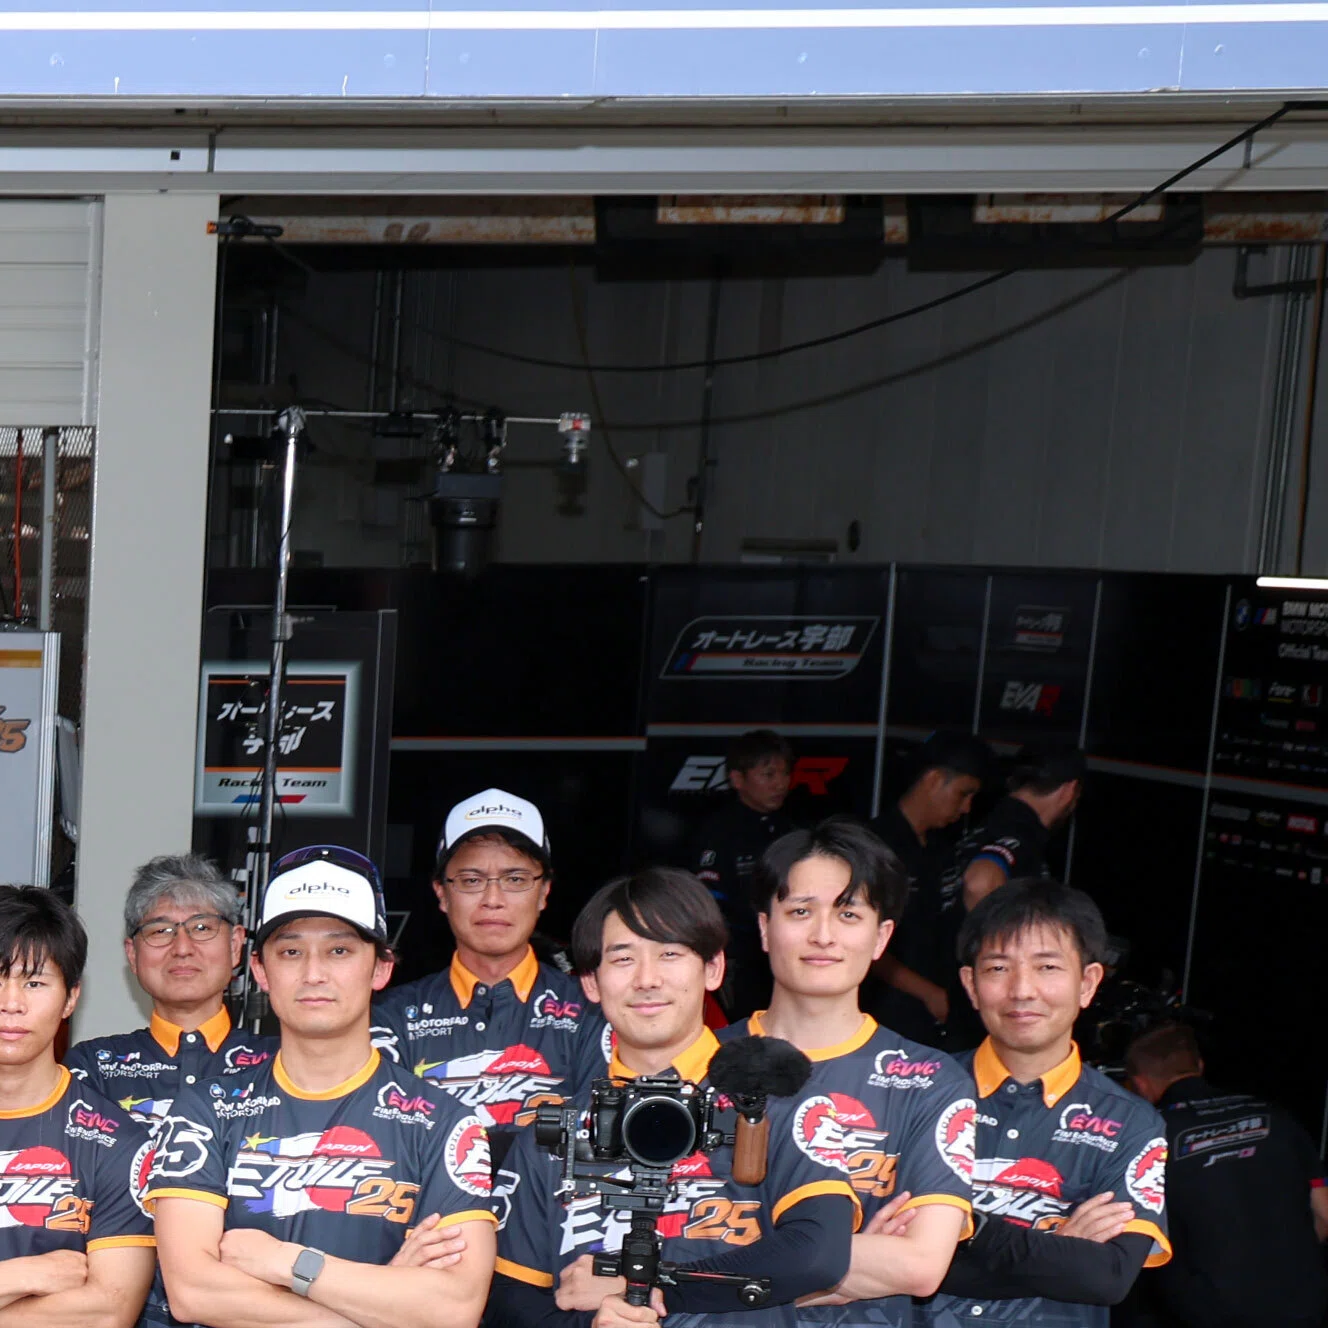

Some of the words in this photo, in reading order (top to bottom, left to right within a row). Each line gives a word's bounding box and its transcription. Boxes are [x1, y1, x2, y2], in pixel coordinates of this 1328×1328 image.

[691, 624, 856, 651] オートレース宇部
[283, 777, 328, 788] Team
[469, 803, 523, 817] alpha
[290, 882, 350, 895] alpha
[492, 1059, 543, 1070] JPON
[75, 1108, 120, 1133] EWC
[316, 1143, 374, 1154] JAPON
[10, 1161, 67, 1172] JAPON
[226, 1152, 396, 1198] ETOILE
[1002, 1174, 1056, 1188] JPON
[346, 1176, 422, 1224] 25
[684, 1196, 763, 1246] 25
